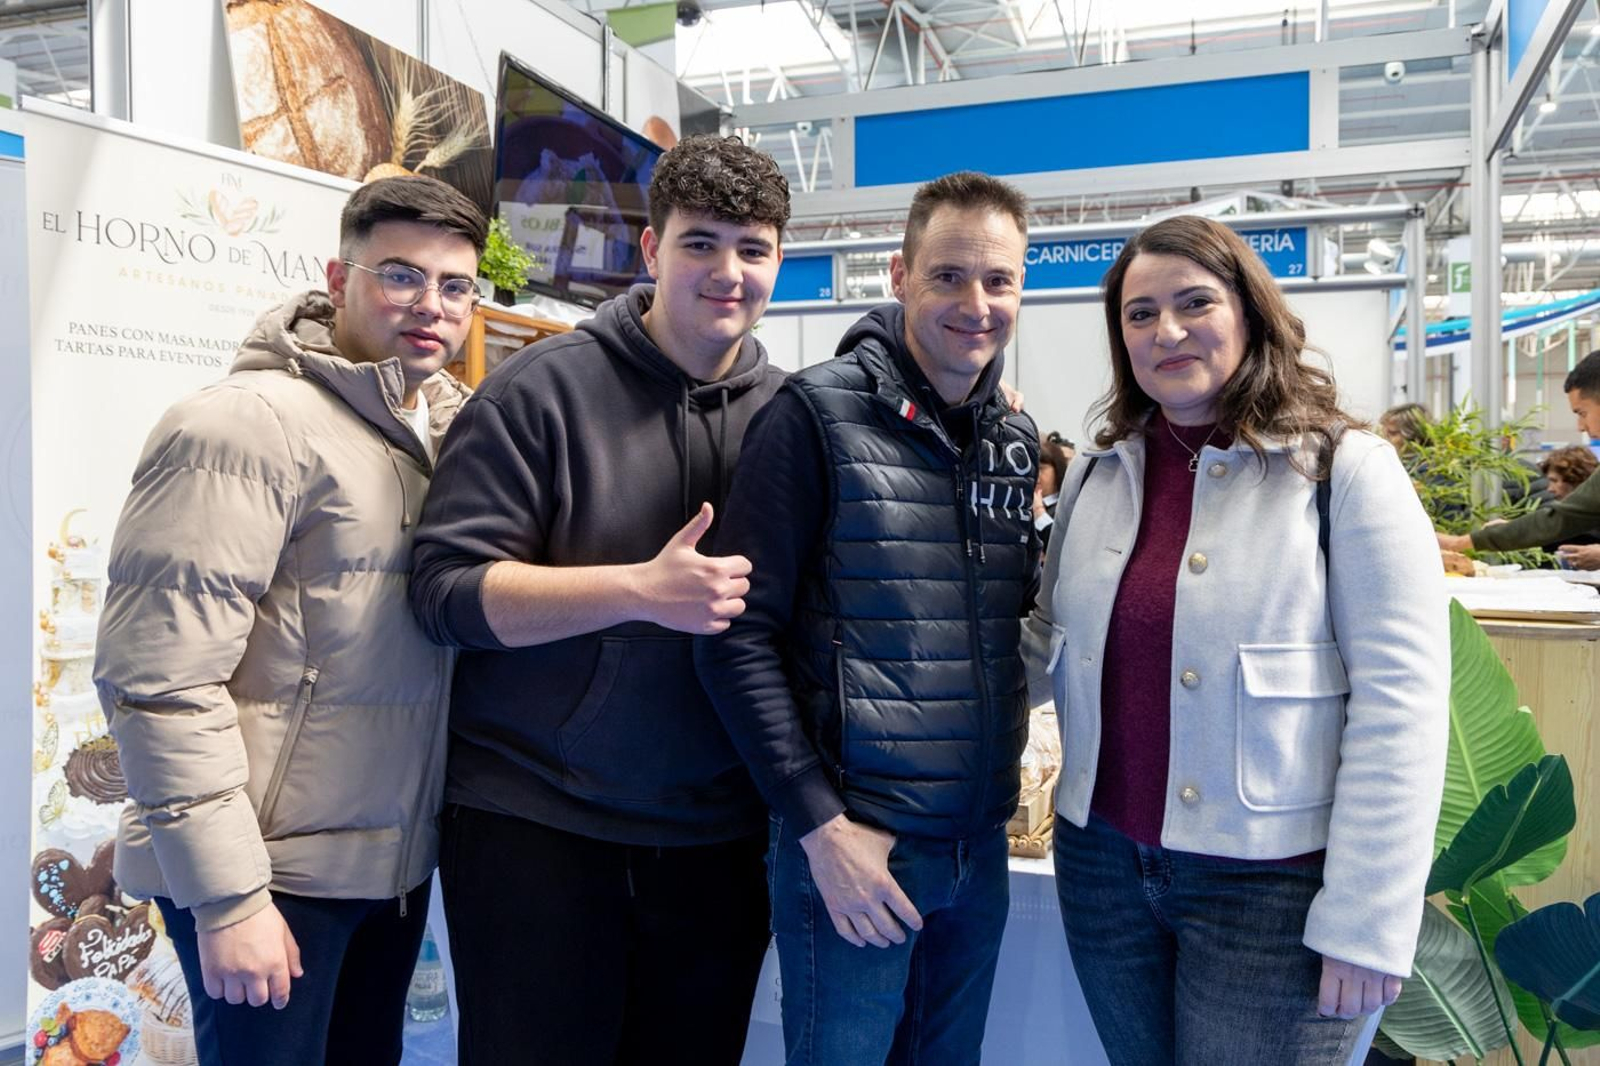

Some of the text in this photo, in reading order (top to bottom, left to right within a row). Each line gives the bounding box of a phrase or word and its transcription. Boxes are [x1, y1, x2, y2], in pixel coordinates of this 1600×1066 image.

[43, 211, 67, 234] EL
[76, 210, 216, 264] HORNO
[228, 246, 252, 265] DE
[119, 267, 225, 293] ARTESANOS
[1288, 263, 1303, 275] 27
[818, 287, 831, 298] 28
[69, 322, 118, 339] PANES
[121, 328, 155, 342] CON
[158, 331, 195, 349] MASA
[54, 339, 114, 356] TARTAS
[118, 345, 156, 361] PARA
[159, 350, 222, 367] EVENTOS
